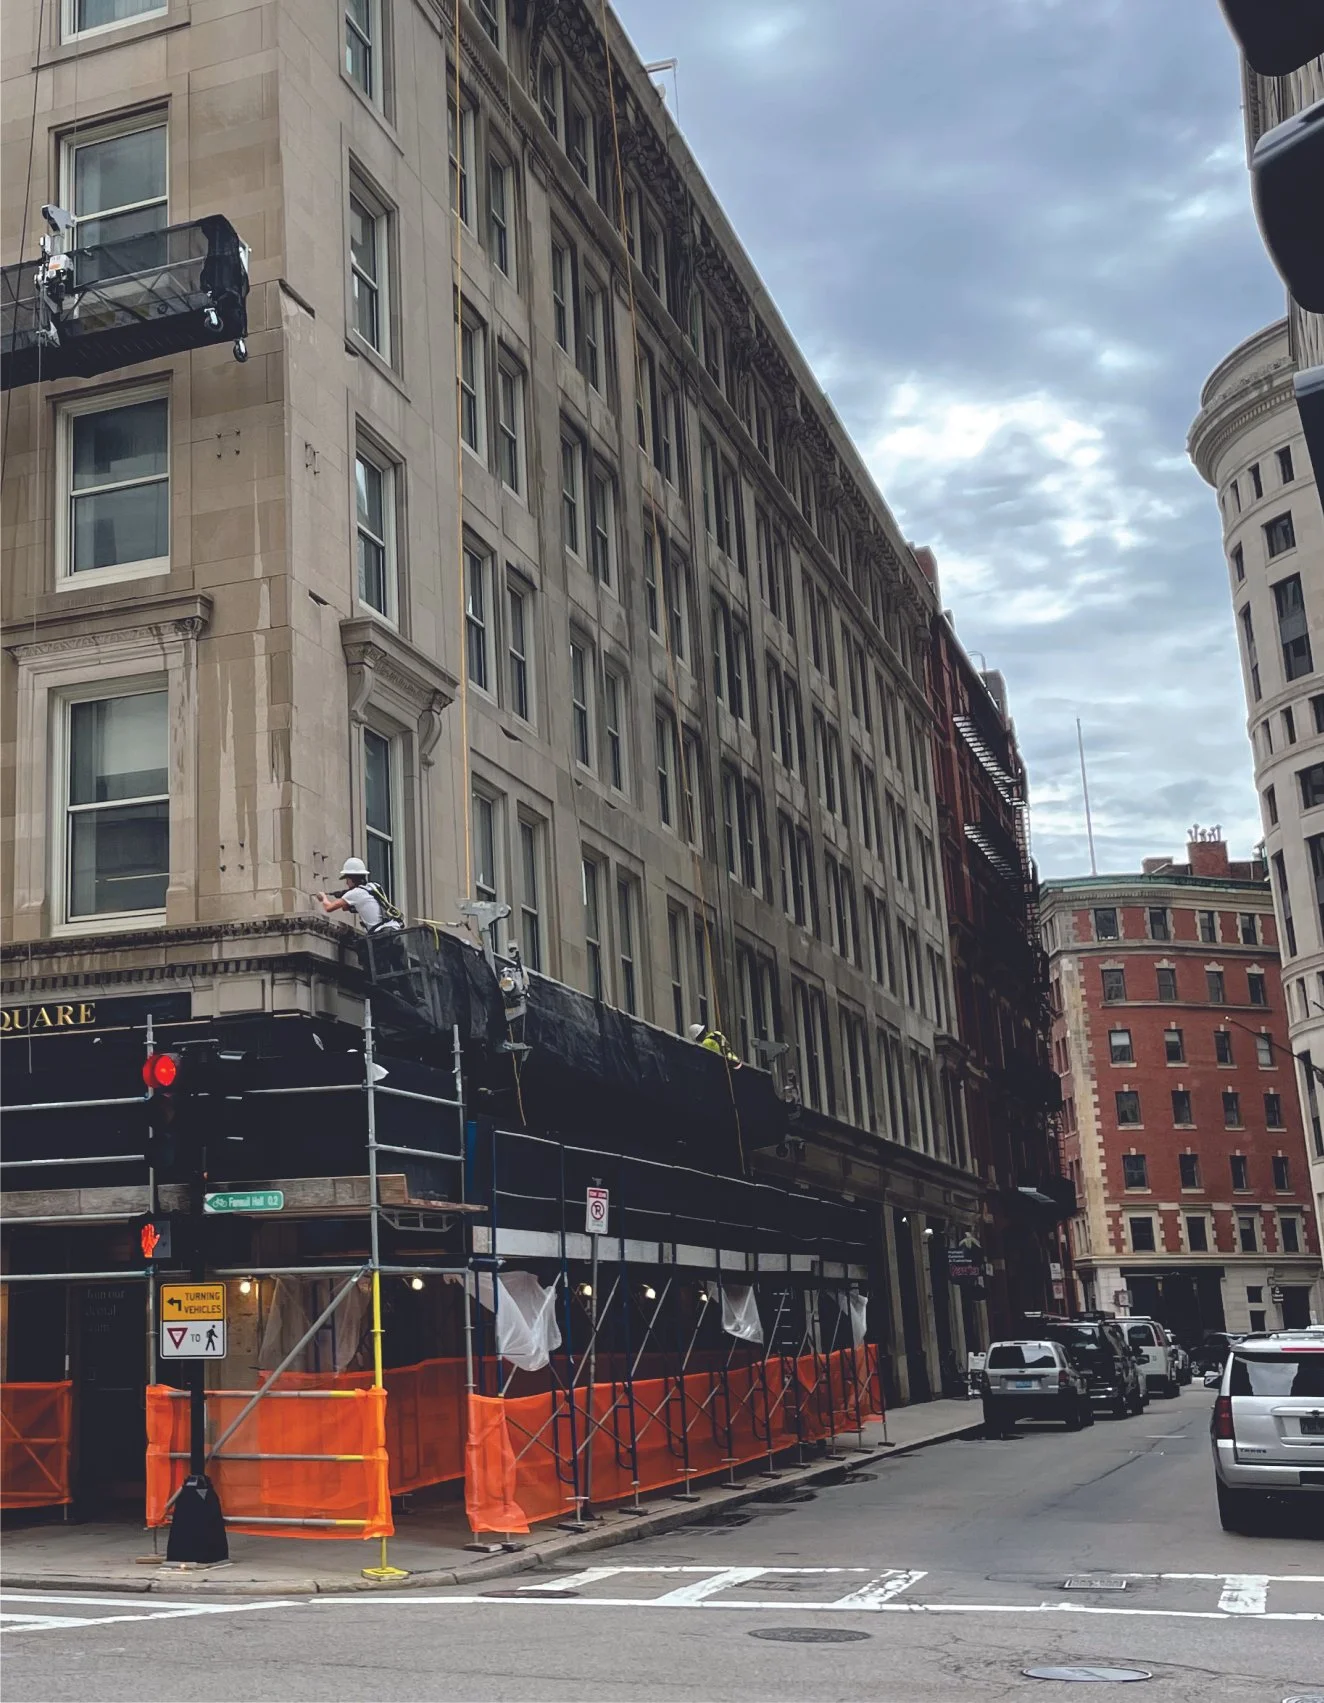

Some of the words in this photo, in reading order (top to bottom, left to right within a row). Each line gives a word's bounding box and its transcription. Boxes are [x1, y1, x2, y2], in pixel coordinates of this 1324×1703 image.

[184, 1291, 221, 1301] TURNING
[184, 1304, 222, 1314] VEHICLES
[190, 1333, 201, 1343] TO
